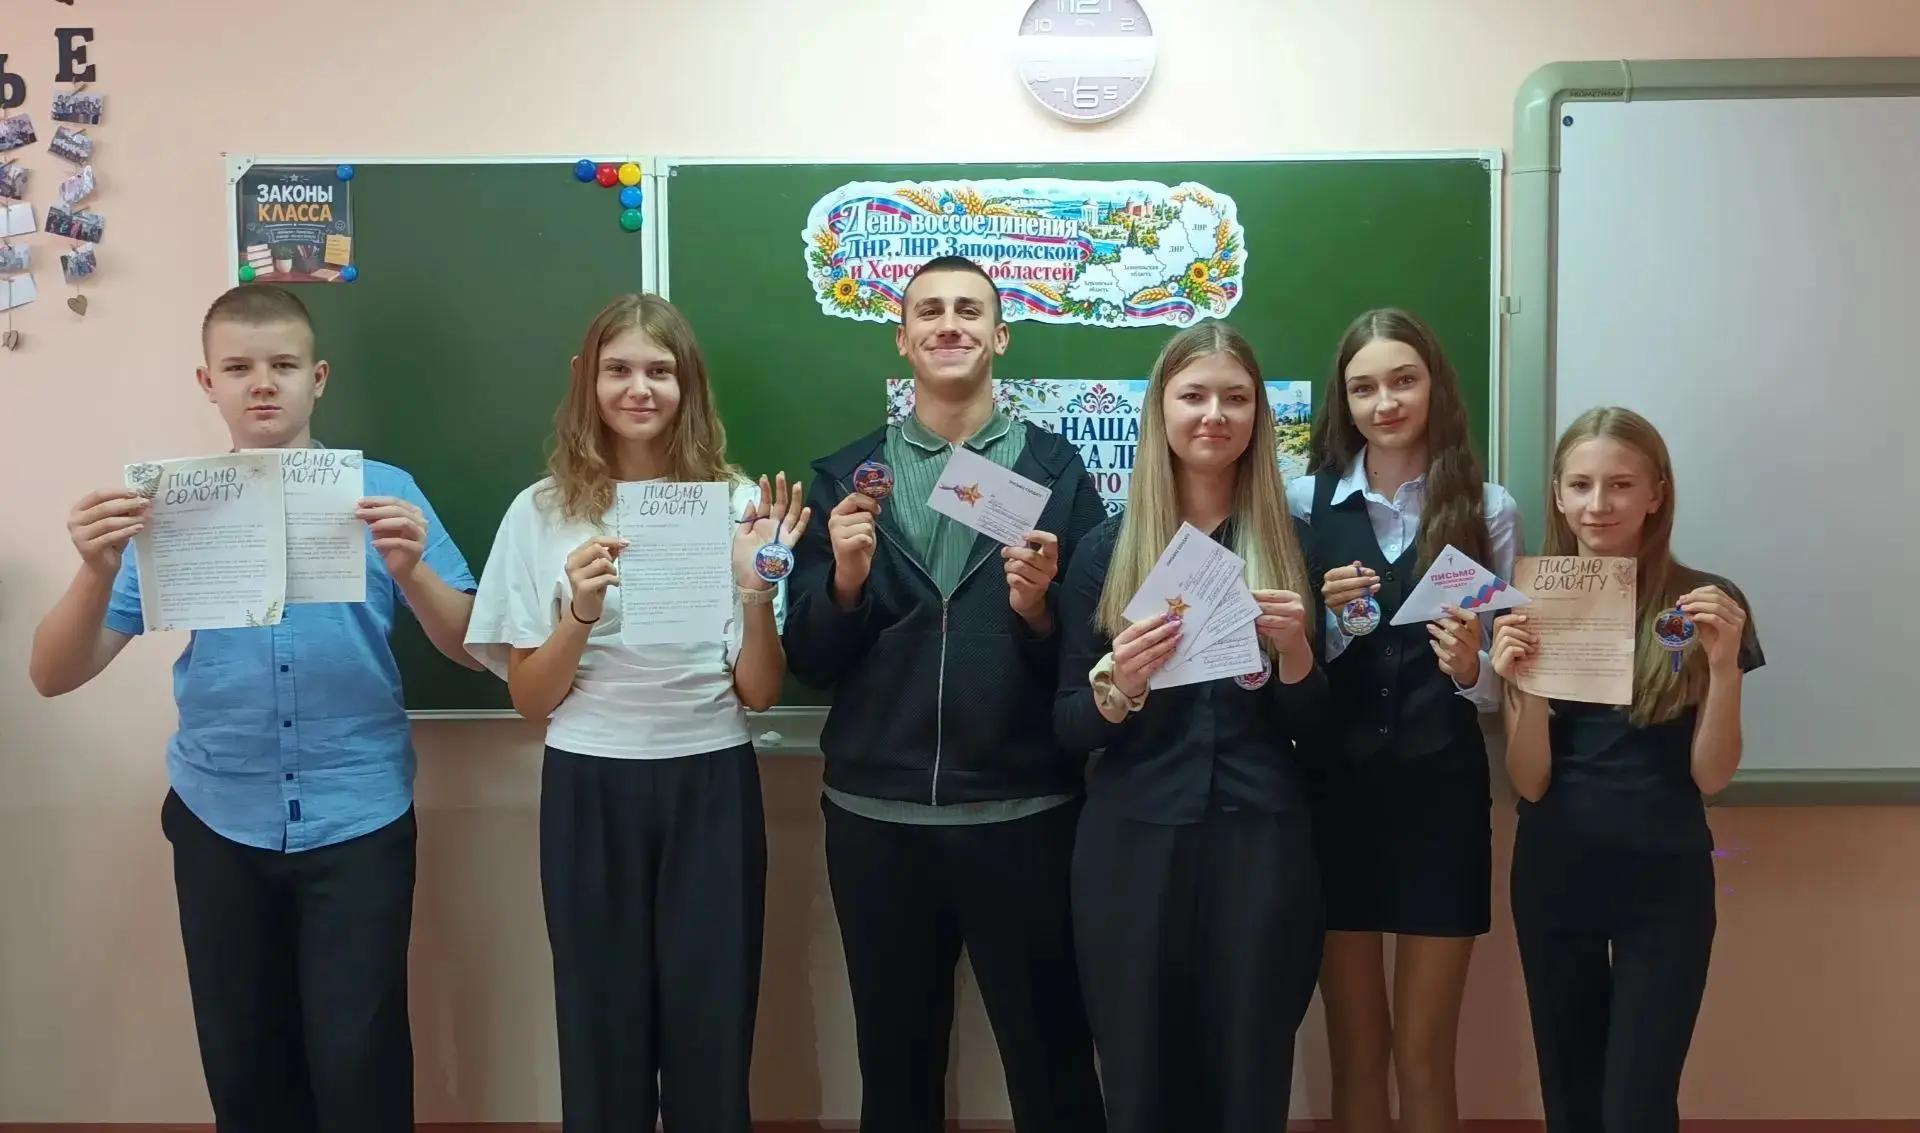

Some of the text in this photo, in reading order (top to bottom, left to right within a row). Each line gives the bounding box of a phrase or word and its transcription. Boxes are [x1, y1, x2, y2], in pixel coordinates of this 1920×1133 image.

[1035, 19, 1052, 32] 10
[1120, 18, 1136, 32] 2
[1073, 85, 1099, 109] 6
[257, 184, 333, 203] ЗАКОНЫ
[258, 204, 333, 222] КЛАССА
[841, 203, 1079, 239] День воссоединения
[847, 239, 892, 262] ДНР,
[945, 236, 1078, 262] Запорожской
[850, 264, 862, 279] и
[989, 261, 1074, 281] областей
[1061, 417, 1139, 441] НАША
[281, 450, 336, 468] ИСЬМО
[169, 467, 236, 489] ПИСЬМО
[282, 467, 341, 486] ЛДАТУ
[165, 483, 243, 505] СОЛДАТУ
[643, 484, 703, 500] ПИСЬМО
[640, 499, 708, 518] СОЛДАТУ
[1430, 569, 1476, 582] ПИСЬМО
[1537, 557, 1603, 577] ПИСЬМО
[1533, 574, 1608, 593] СОЛДАТУ
